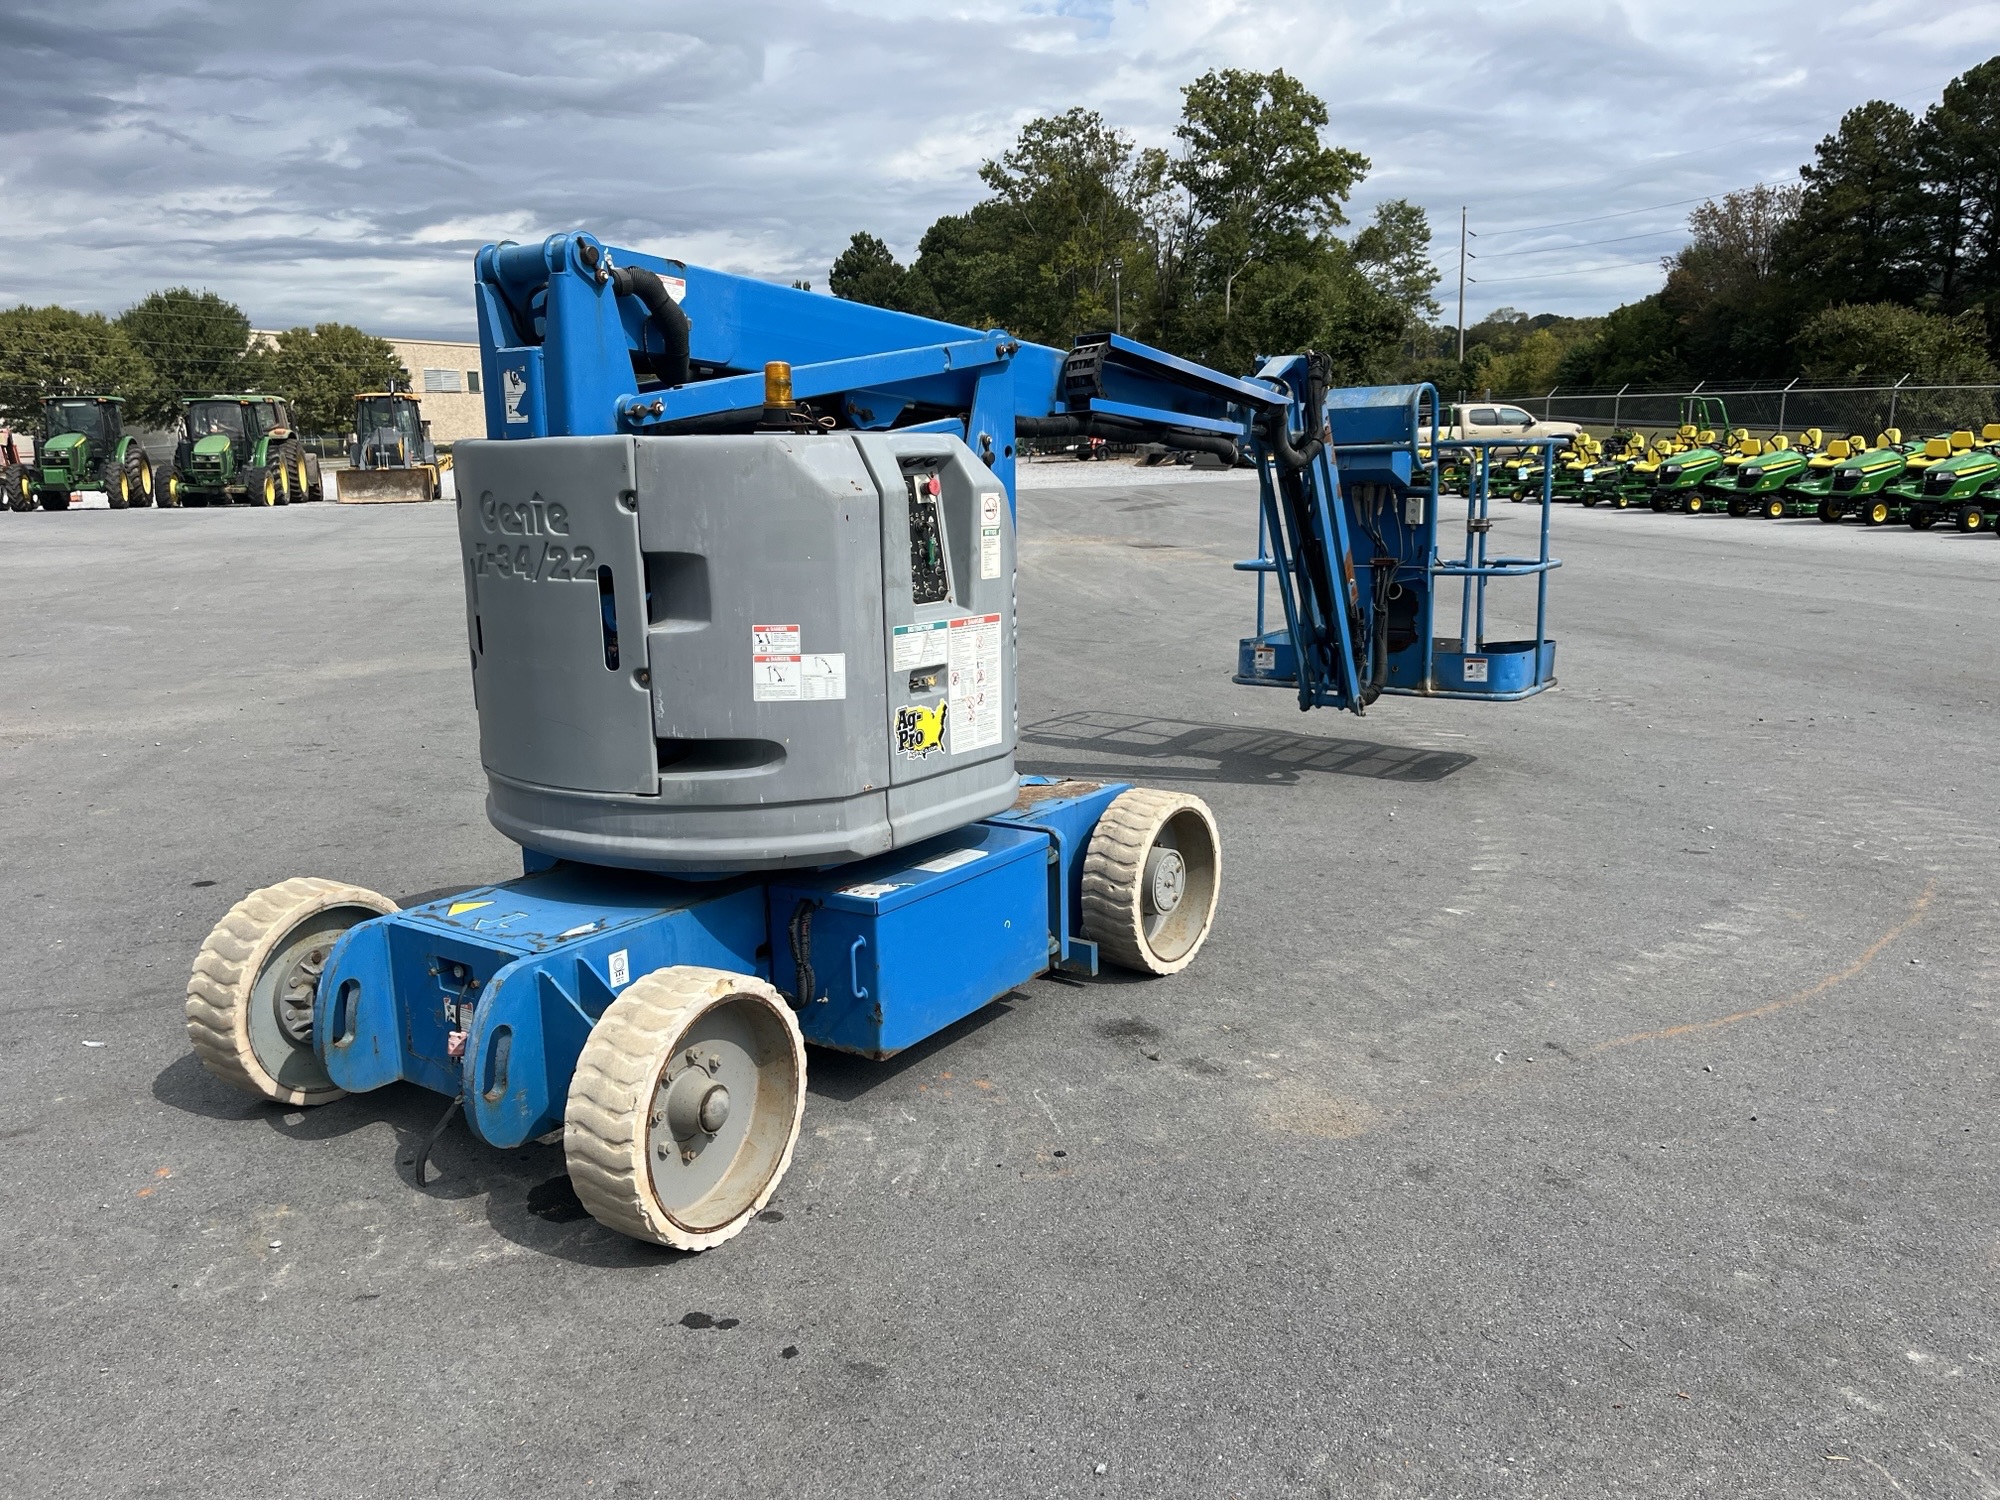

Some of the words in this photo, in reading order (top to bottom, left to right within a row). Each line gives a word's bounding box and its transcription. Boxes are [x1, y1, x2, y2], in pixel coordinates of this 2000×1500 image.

[480, 490, 569, 536] Genie
[476, 541, 597, 583] Z-34/22
[898, 709, 922, 731] Ag-
[898, 730, 924, 751] Pro
